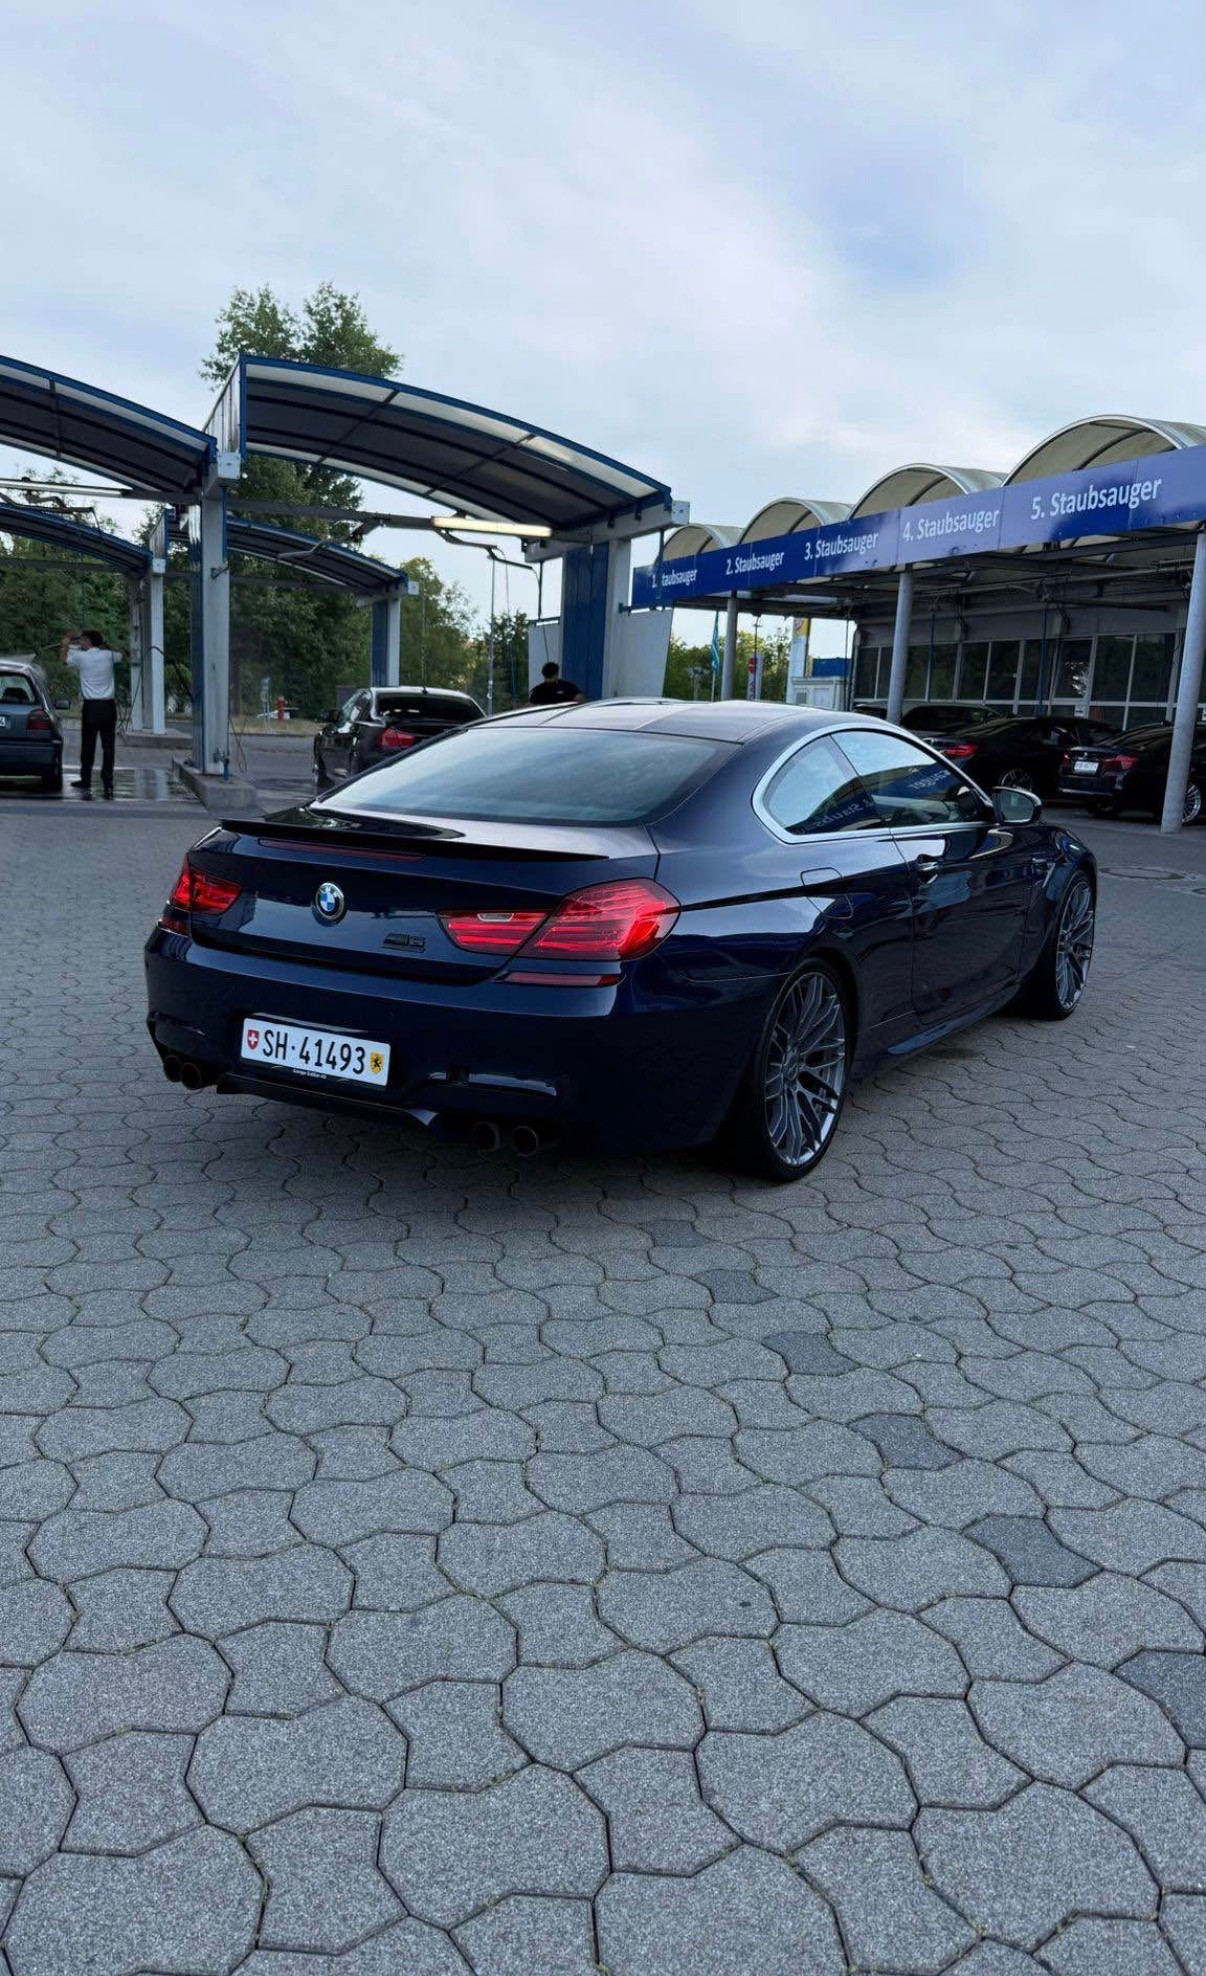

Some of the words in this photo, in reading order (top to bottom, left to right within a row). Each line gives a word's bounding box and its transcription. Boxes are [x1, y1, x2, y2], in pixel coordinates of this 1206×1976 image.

[1030, 496, 1045, 520] 5.
[1050, 477, 1162, 517] Staubsauger
[902, 524, 914, 542] 4.
[917, 508, 999, 540] Staubsauger
[804, 542, 814, 561] 3.
[815, 531, 879, 559] Staubsauger
[661, 568, 698, 587] taubsauger
[726, 558, 736, 575] 2.
[735, 551, 784, 574] Staubsauger
